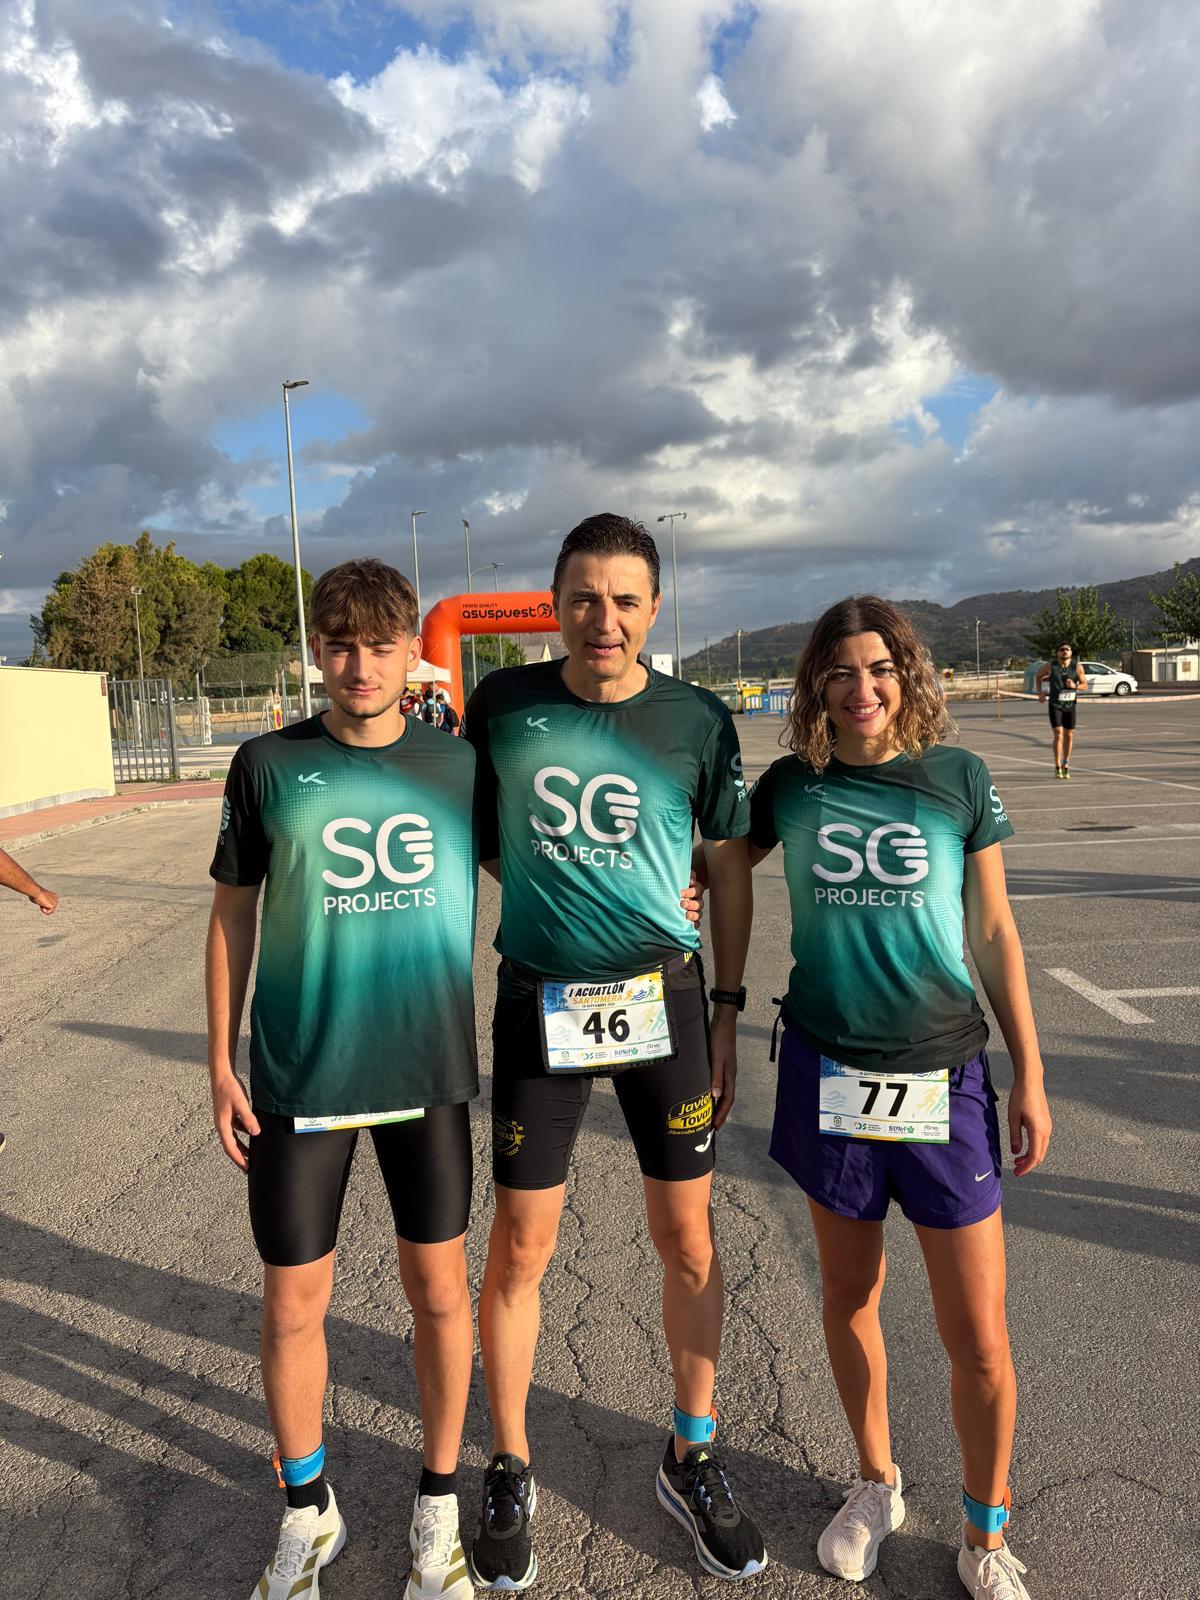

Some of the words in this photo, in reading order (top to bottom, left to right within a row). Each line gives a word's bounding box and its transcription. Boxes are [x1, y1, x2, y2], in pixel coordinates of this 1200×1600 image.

[529, 766, 641, 843] SG
[322, 813, 435, 889] SG
[530, 839, 633, 870] PROJECTS
[811, 822, 929, 885] SG
[323, 887, 437, 916] PROJECTS
[814, 887, 926, 909] PROJECTS
[572, 995, 623, 1005] SANTOMERA
[574, 980, 626, 998] ACUATLÓN
[582, 1008, 631, 1045] 46
[858, 1080, 909, 1117] 77
